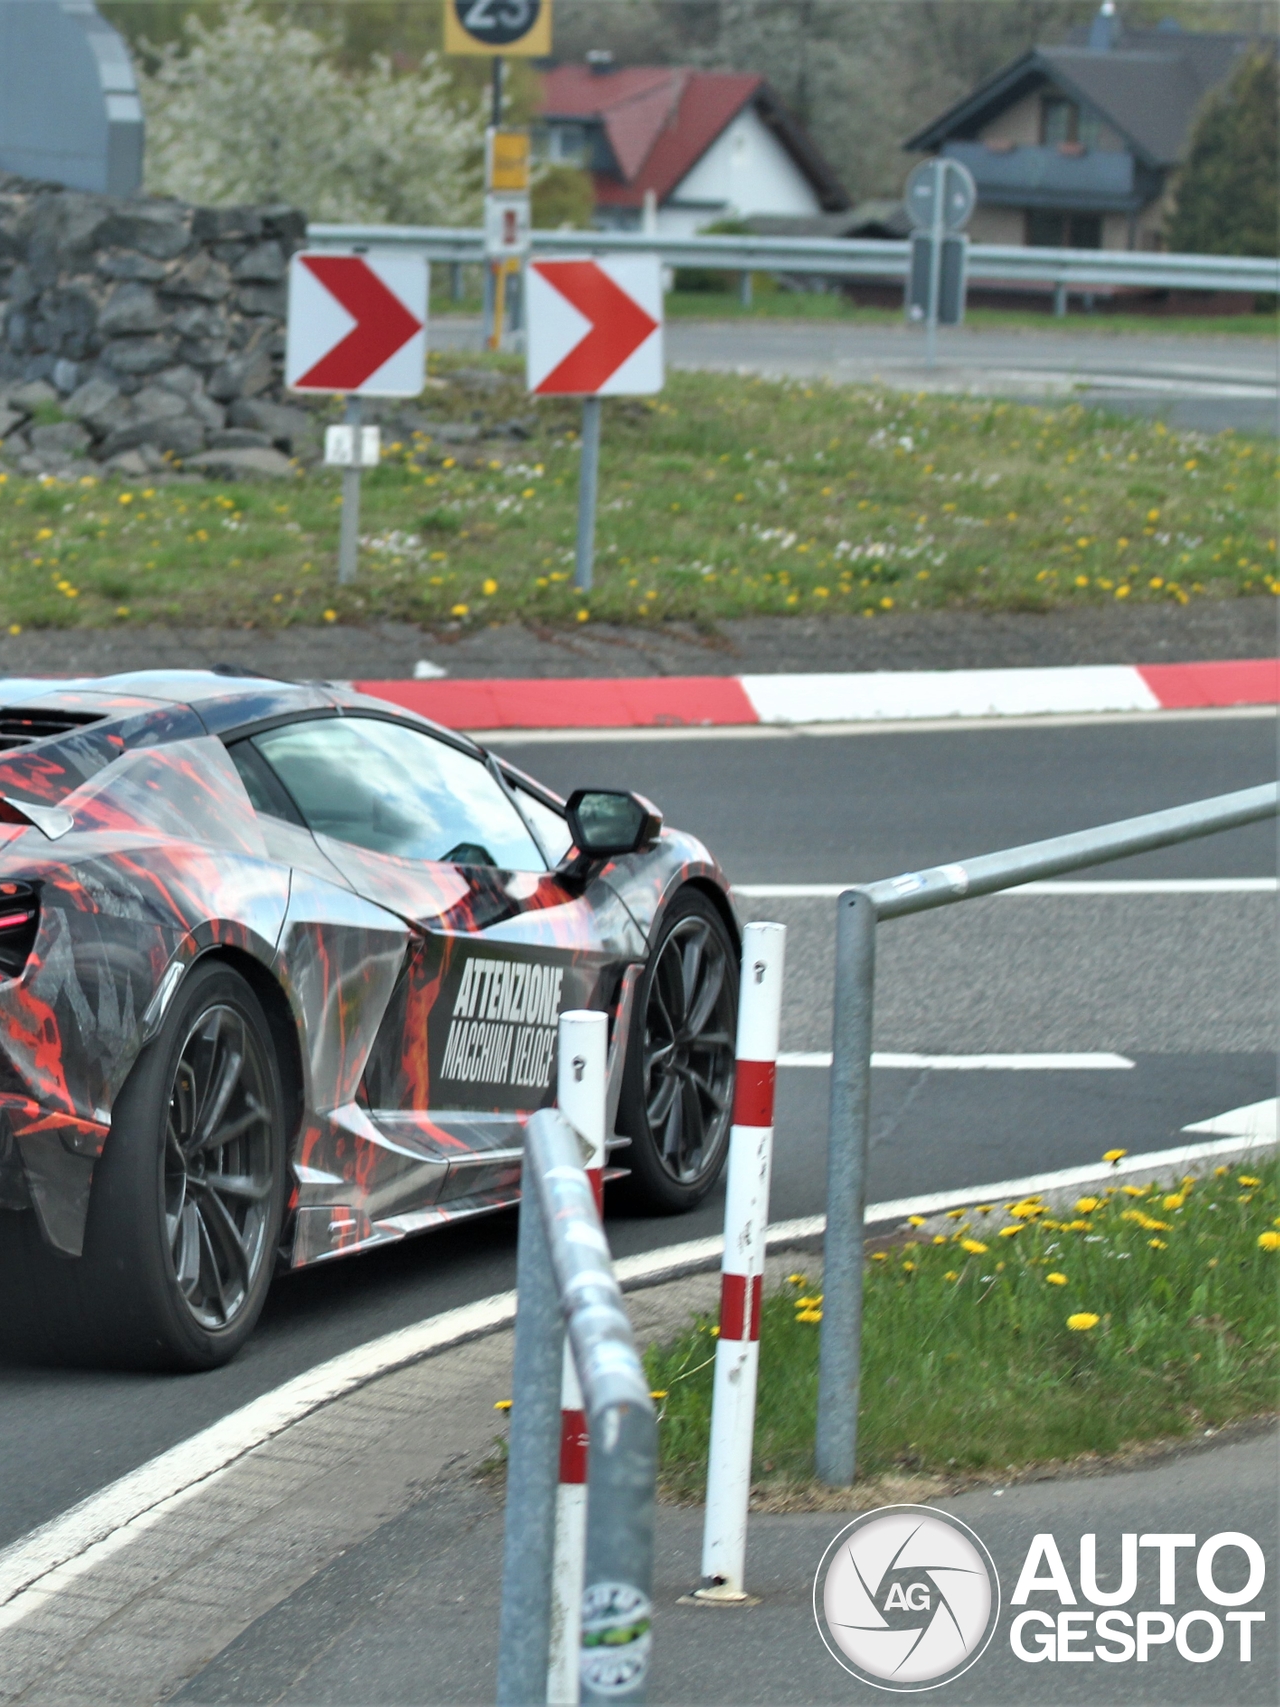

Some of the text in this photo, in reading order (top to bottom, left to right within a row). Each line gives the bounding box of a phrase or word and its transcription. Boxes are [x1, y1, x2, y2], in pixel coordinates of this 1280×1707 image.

[452, 957, 564, 1026] ATTENZIONE
[440, 1020, 557, 1088] MACCHINA VELOCE
